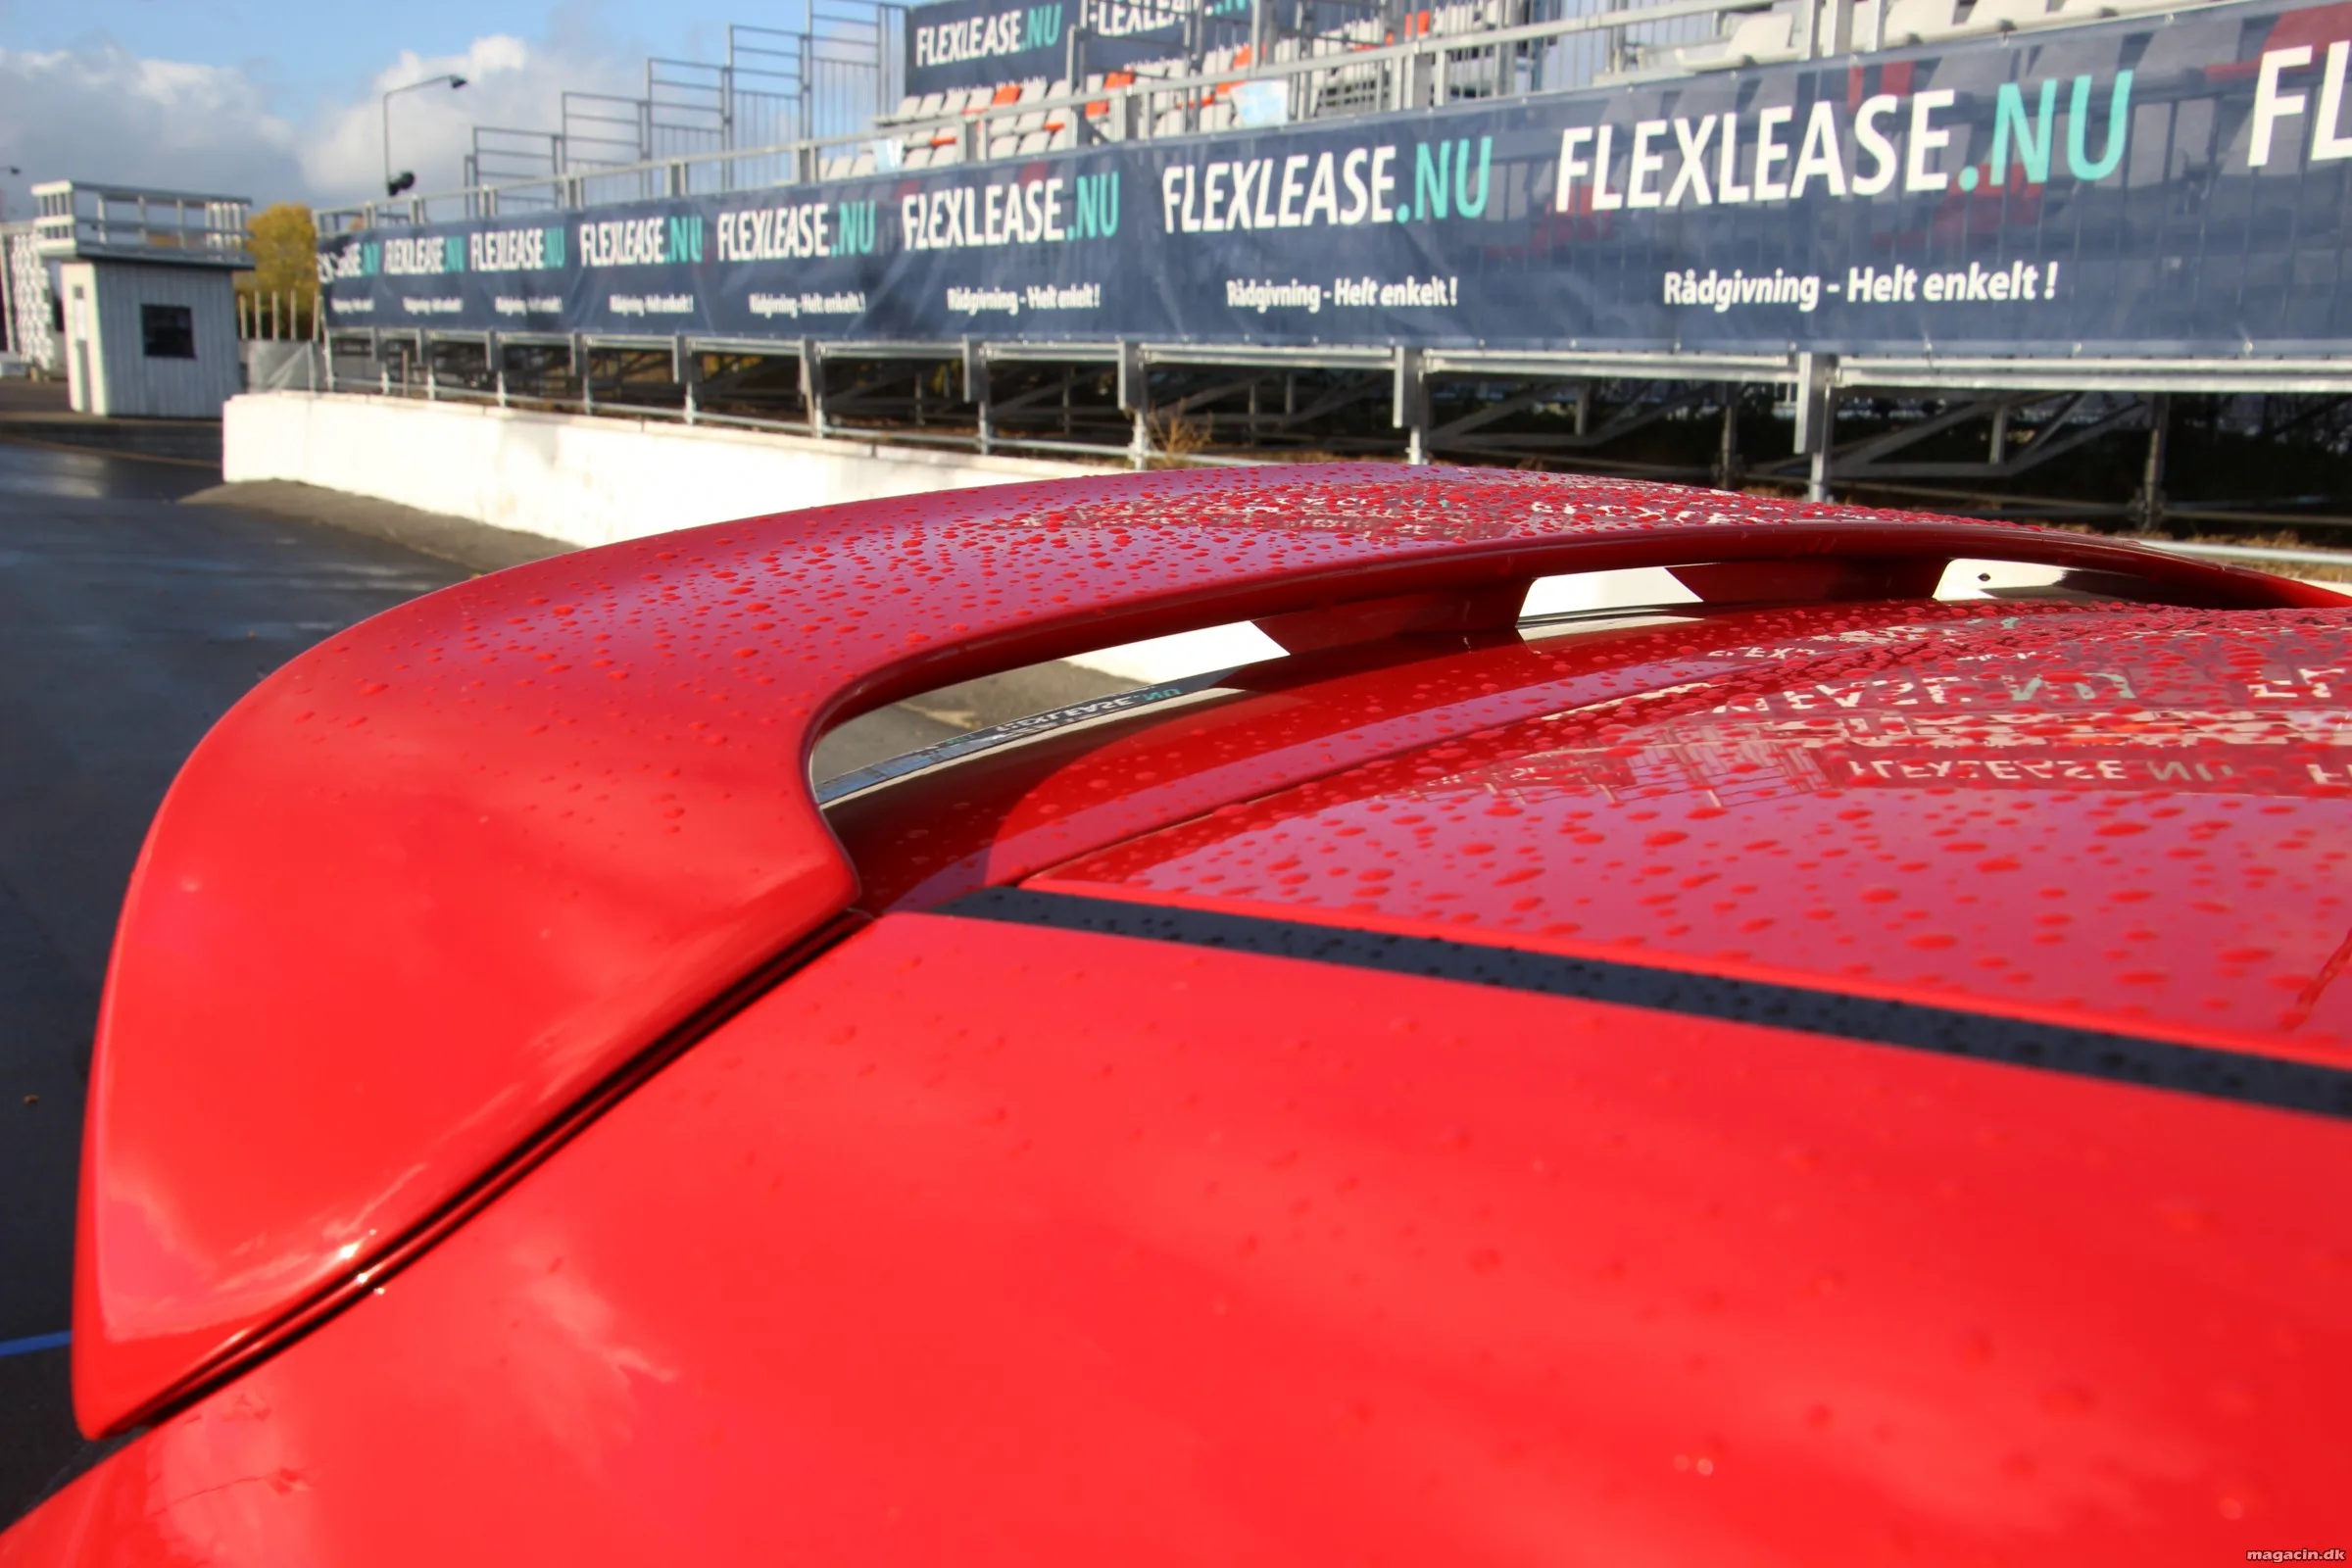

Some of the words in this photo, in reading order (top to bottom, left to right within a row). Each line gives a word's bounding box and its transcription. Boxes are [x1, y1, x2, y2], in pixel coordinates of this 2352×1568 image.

[915, 2, 1061, 68] FLEXLEASE.NU
[2247, 39, 2352, 167] FL
[1555, 70, 2132, 213] FLEXLEASE.NU
[902, 171, 1119, 251] FLEXLEASE.NU
[1162, 136, 1493, 233] FLEXLEASE.NU
[579, 216, 703, 268] FLEXLEASE.NU
[717, 199, 876, 262] FLEXLEASE.NU
[1334, 276, 1379, 307] Helt
[1663, 269, 1820, 313] Rådgivning
[1846, 265, 1917, 302] Helt
